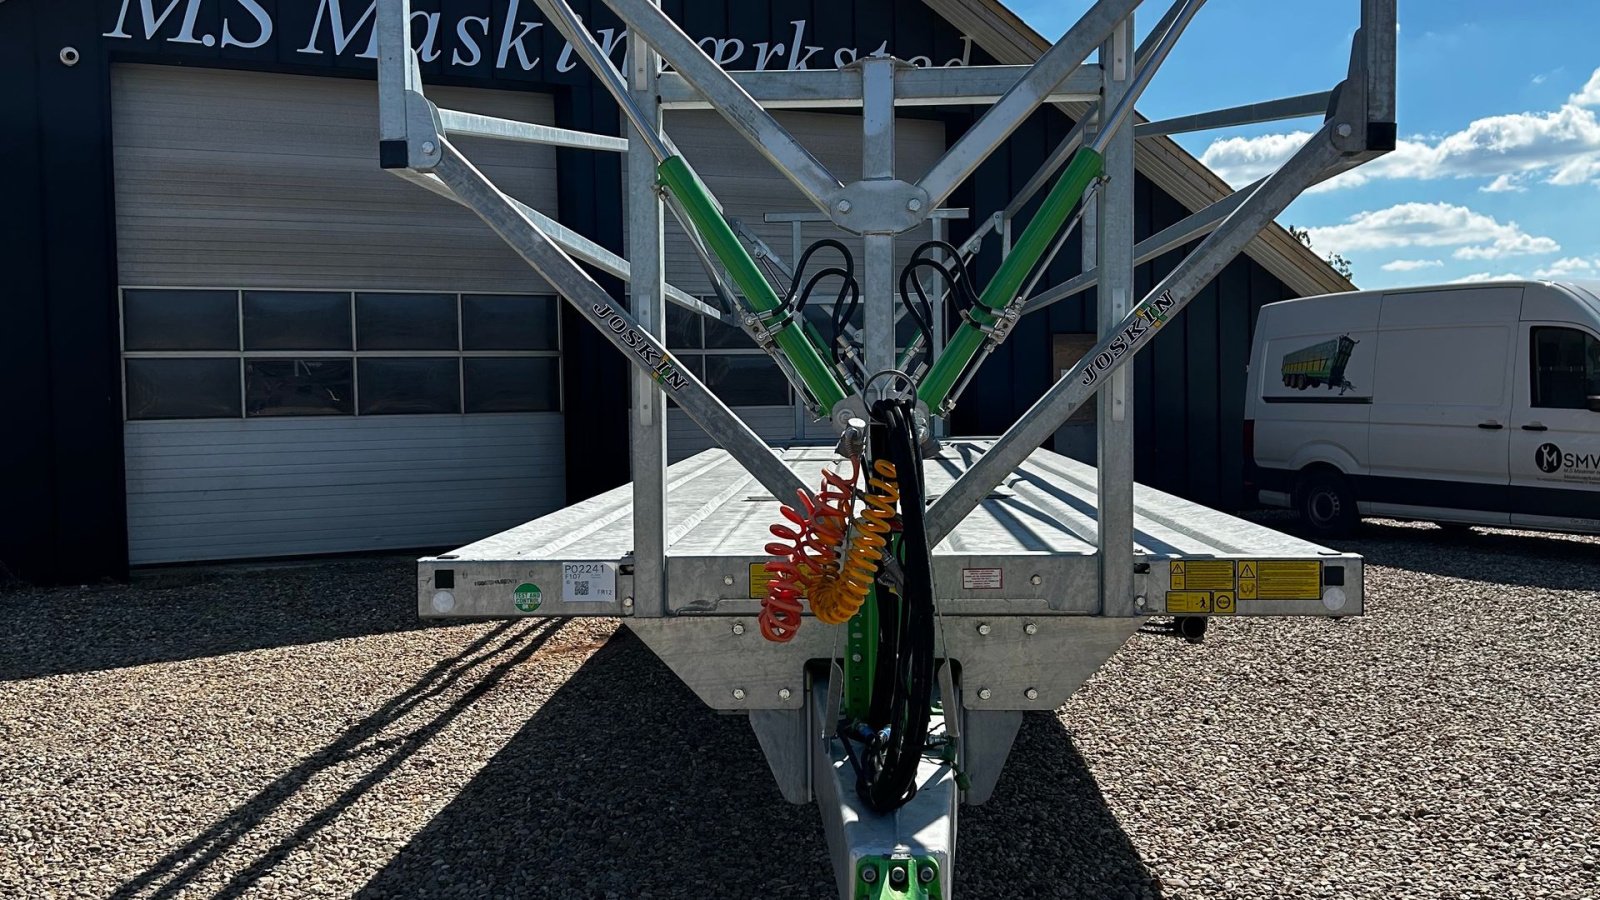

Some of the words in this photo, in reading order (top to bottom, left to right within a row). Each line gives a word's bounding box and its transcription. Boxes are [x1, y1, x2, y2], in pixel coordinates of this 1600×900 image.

[296, 0, 972, 75] Maskiærksd
[592, 303, 689, 391] JOSKIN
[1082, 289, 1176, 386] JOSKIN
